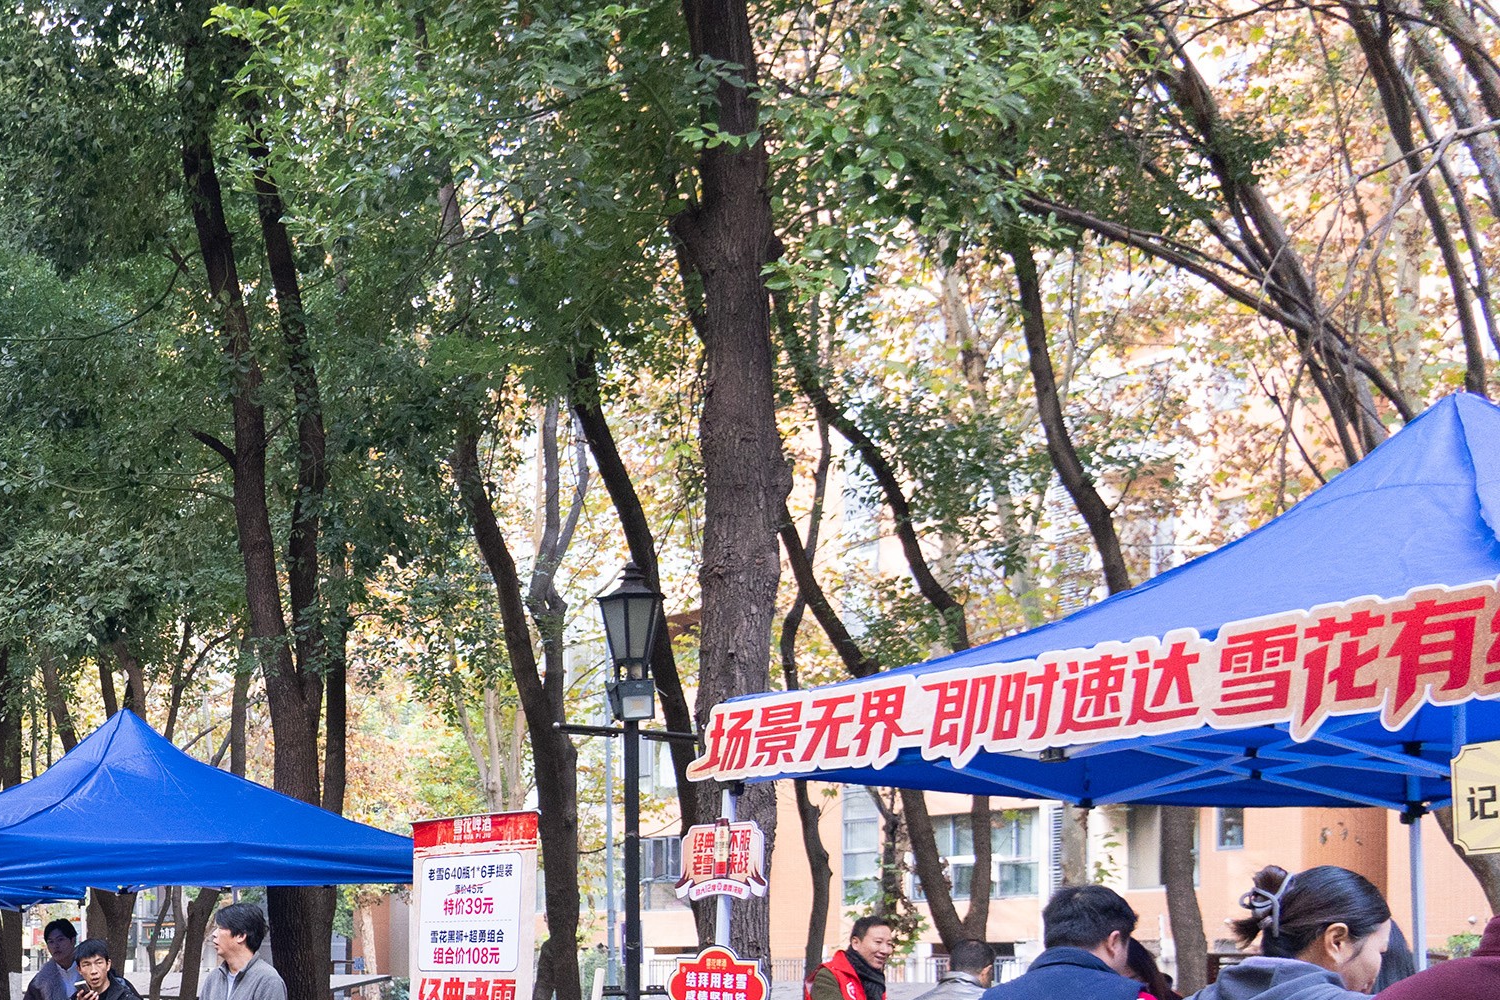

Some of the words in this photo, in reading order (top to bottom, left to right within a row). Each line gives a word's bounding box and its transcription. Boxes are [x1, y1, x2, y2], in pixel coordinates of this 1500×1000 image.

[692, 685, 923, 773] 场景无界
[922, 641, 1200, 760] 即时速达
[1211, 596, 1500, 727] 雪花有
[453, 816, 492, 834] 雪花啤酒
[693, 832, 715, 853] 经典
[730, 829, 751, 851] 不服
[693, 854, 714, 875] 老雪
[729, 852, 750, 875] 来战
[443, 897, 494, 916] 特价39元
[433, 947, 500, 965] 组合价108元
[685, 972, 748, 990] 结拜用老雪
